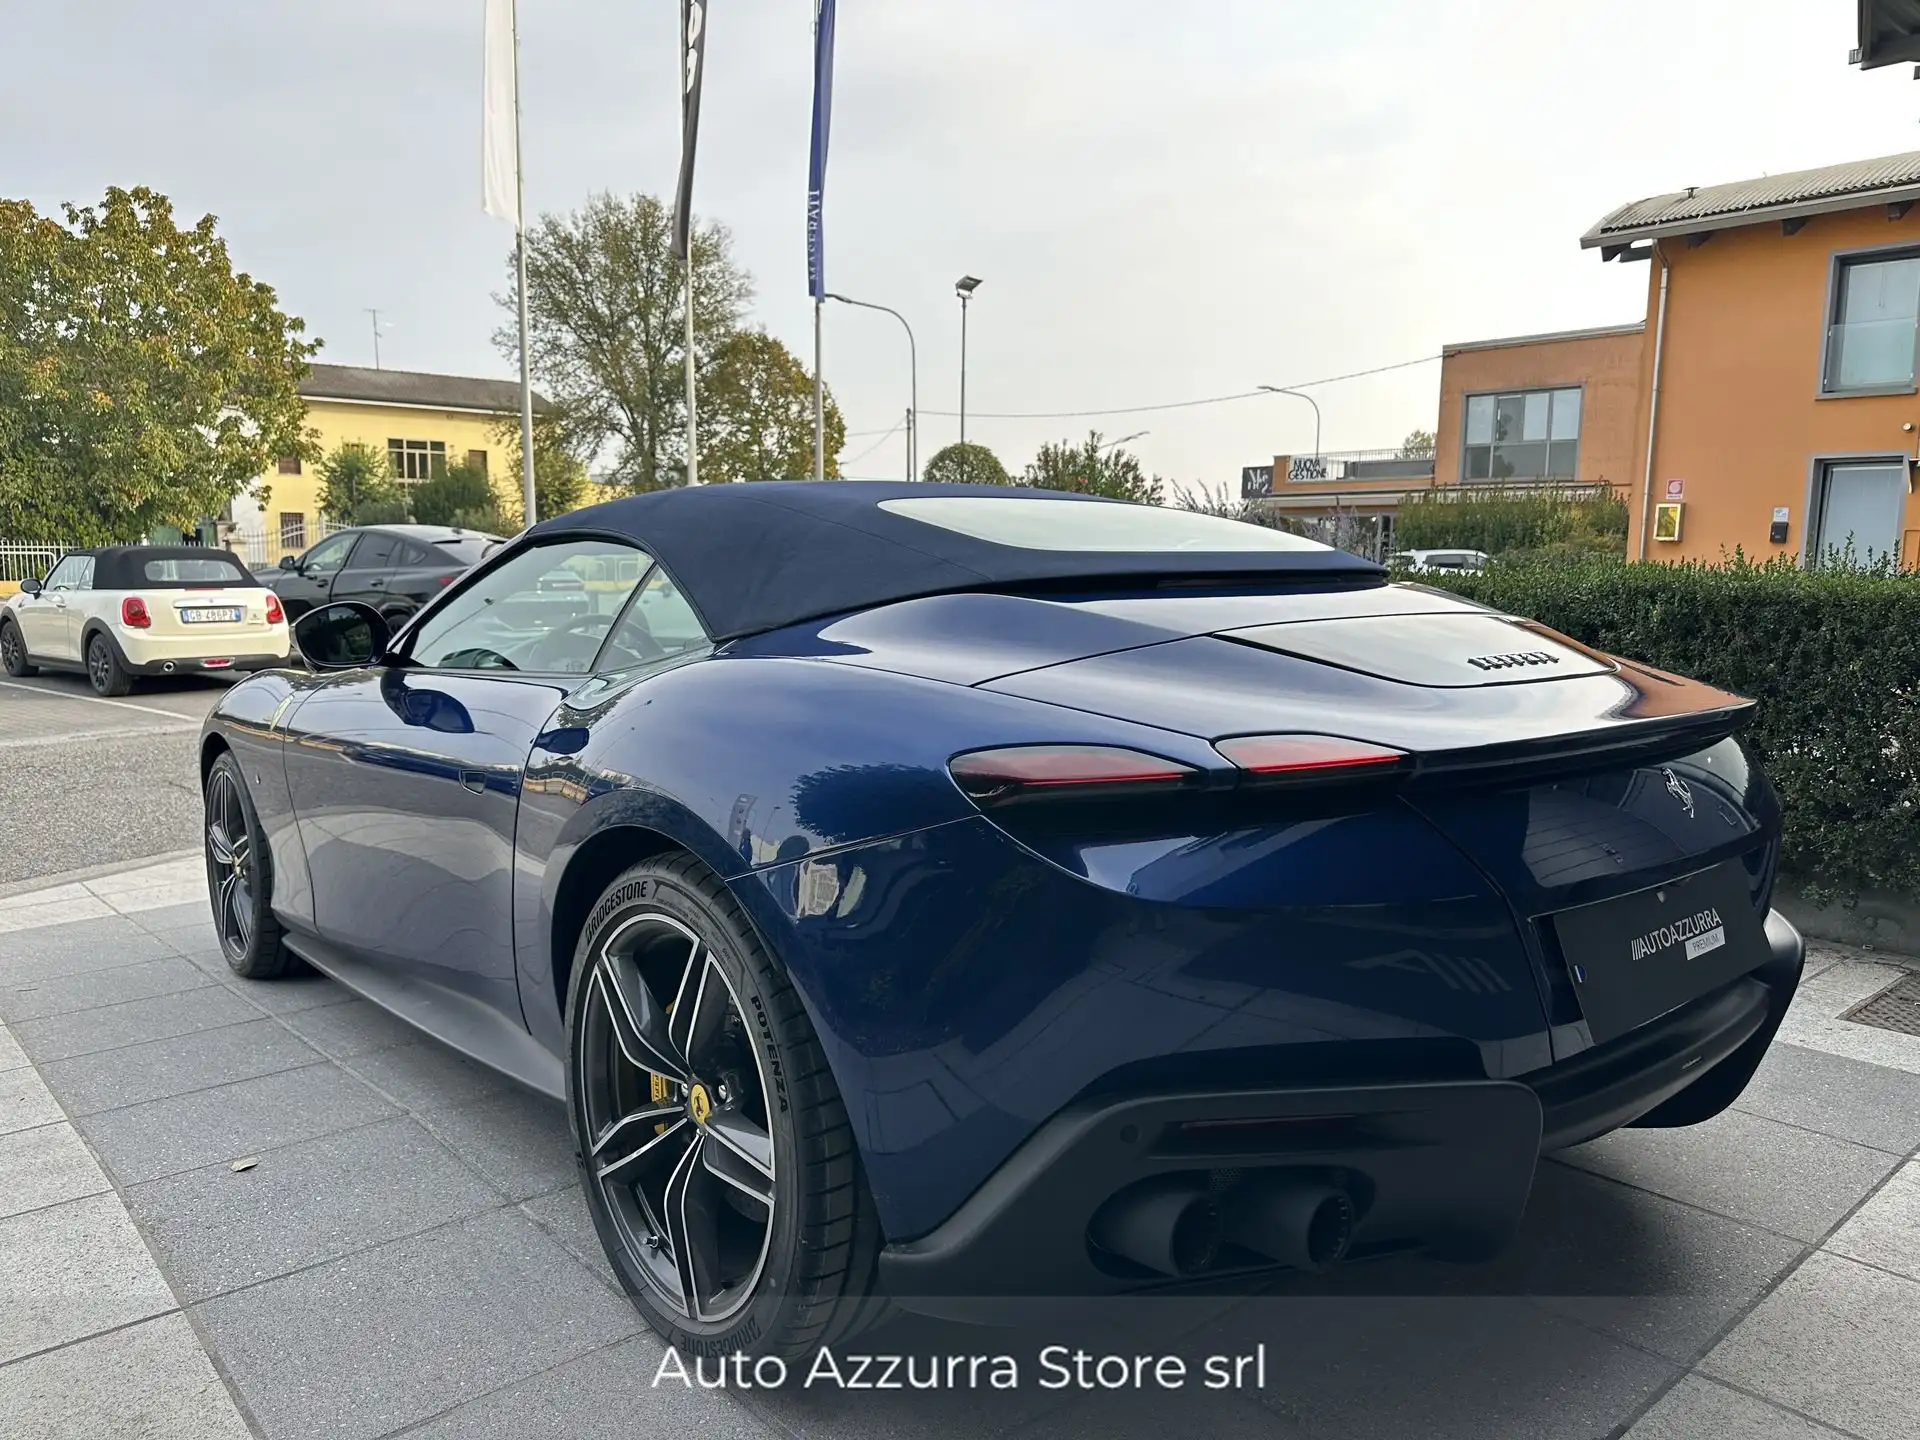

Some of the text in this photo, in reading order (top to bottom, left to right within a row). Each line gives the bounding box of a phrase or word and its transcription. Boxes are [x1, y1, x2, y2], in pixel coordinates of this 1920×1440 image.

[1288, 467, 1327, 481] GESTIONE
[1293, 458, 1321, 471] NUOVA
[585, 880, 648, 946] BRIDGESTONE
[1692, 933, 1720, 952] PREMIUM
[750, 995, 788, 1113] POTENZA
